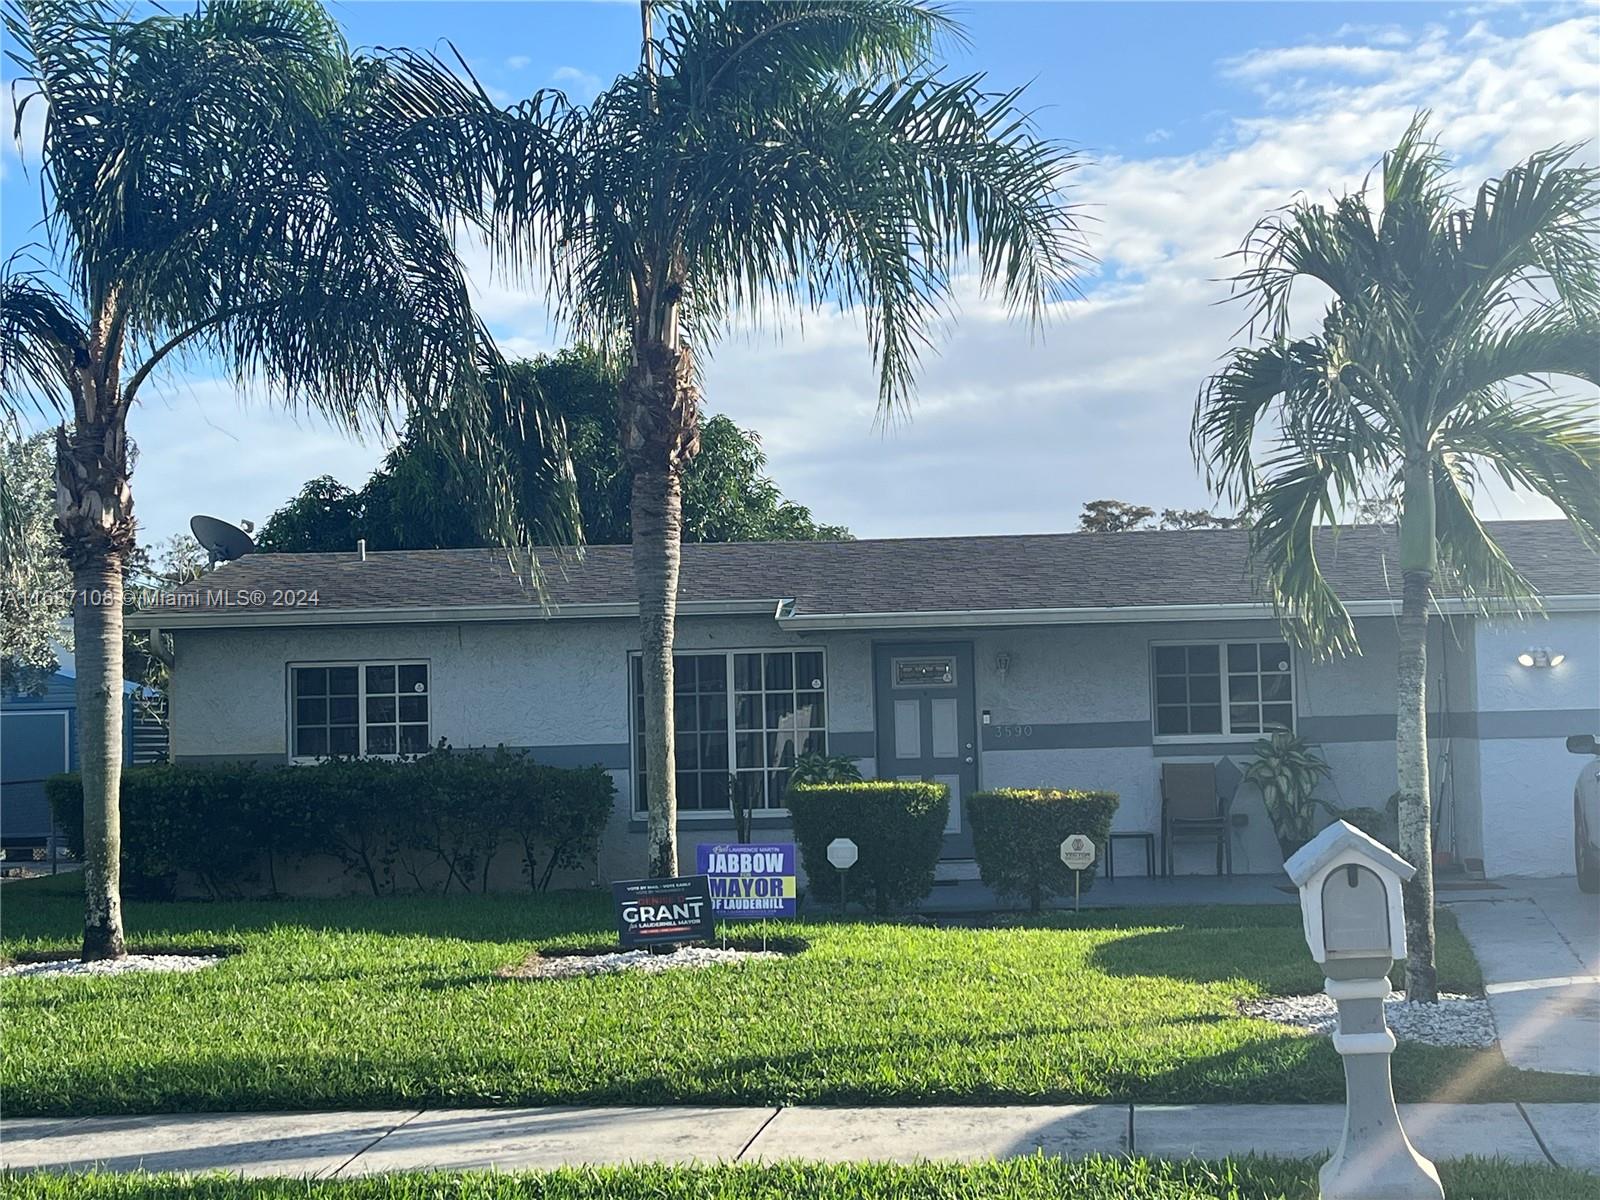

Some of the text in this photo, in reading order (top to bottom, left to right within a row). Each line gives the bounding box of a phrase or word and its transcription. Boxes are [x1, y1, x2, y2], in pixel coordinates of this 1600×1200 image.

[994, 725, 1033, 738] 3590
[707, 853, 784, 873] JABBOW
[709, 878, 784, 898] MAYOR
[723, 898, 784, 910] LAUDERHILL
[622, 902, 704, 923] GRANT
[638, 920, 677, 929] LAUDERHILL
